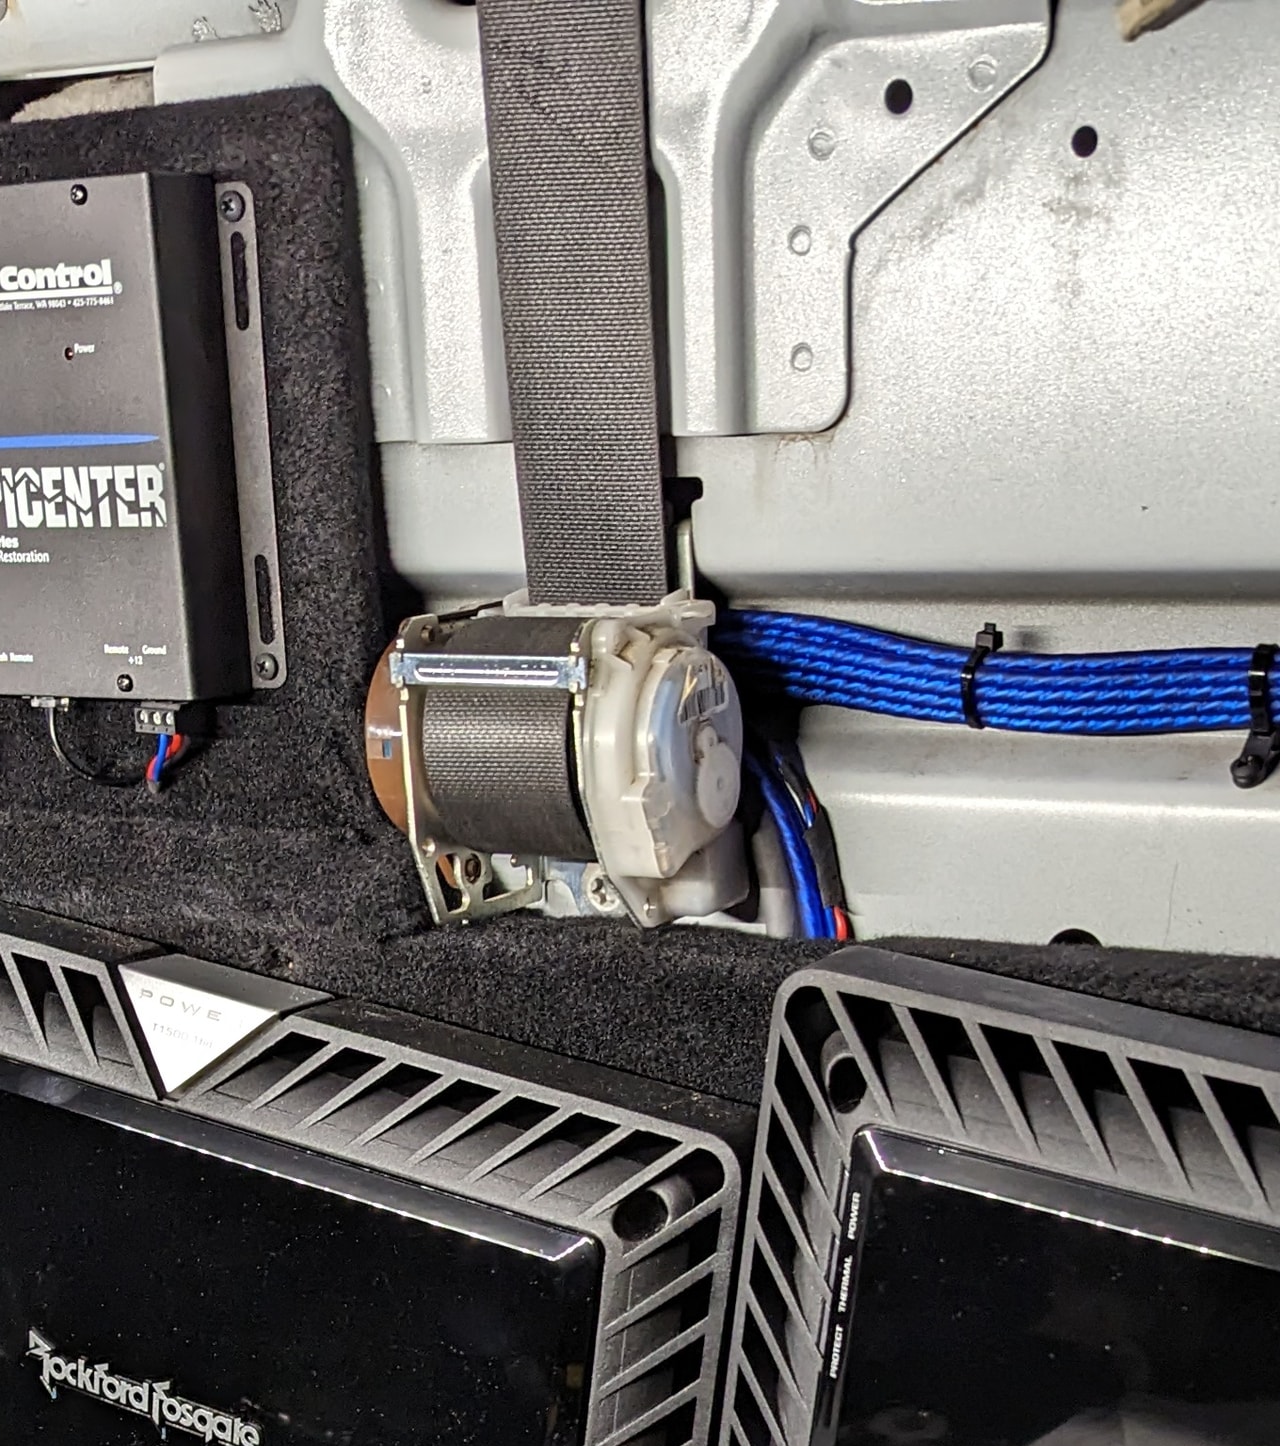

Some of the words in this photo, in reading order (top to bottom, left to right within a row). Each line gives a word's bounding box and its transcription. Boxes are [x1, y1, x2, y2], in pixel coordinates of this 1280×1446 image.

[73, 343, 95, 354] Power
[103, 644, 129, 655] Remote
[141, 644, 167, 655] Ground
[9, 652, 34, 663] Remote
[139, 988, 238, 1028] POWE
[829, 1323, 844, 1379] PROTECT
[837, 1254, 853, 1313] THERMAL
[847, 1191, 861, 1240] POWER
[26, 1329, 150, 1413] Rockford
